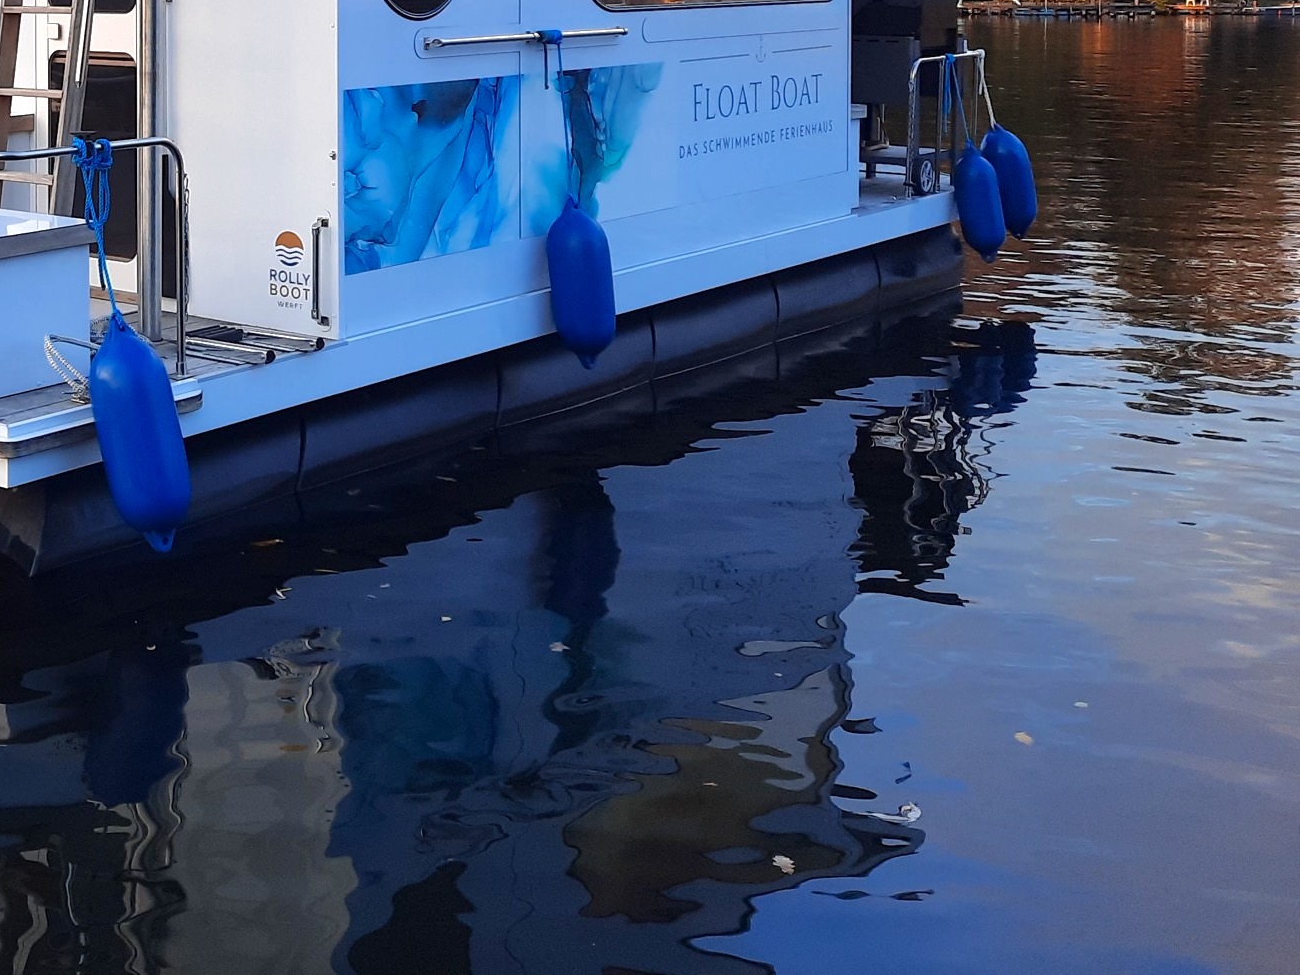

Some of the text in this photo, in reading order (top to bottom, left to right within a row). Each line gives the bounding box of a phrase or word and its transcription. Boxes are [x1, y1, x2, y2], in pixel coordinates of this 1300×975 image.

[692, 73, 823, 122] FLOAT BOAT
[679, 119, 833, 159] DAS SCHWIMMENDE FERIENHAUS
[269, 268, 311, 286] ROLLY
[269, 283, 311, 301] BOOT
